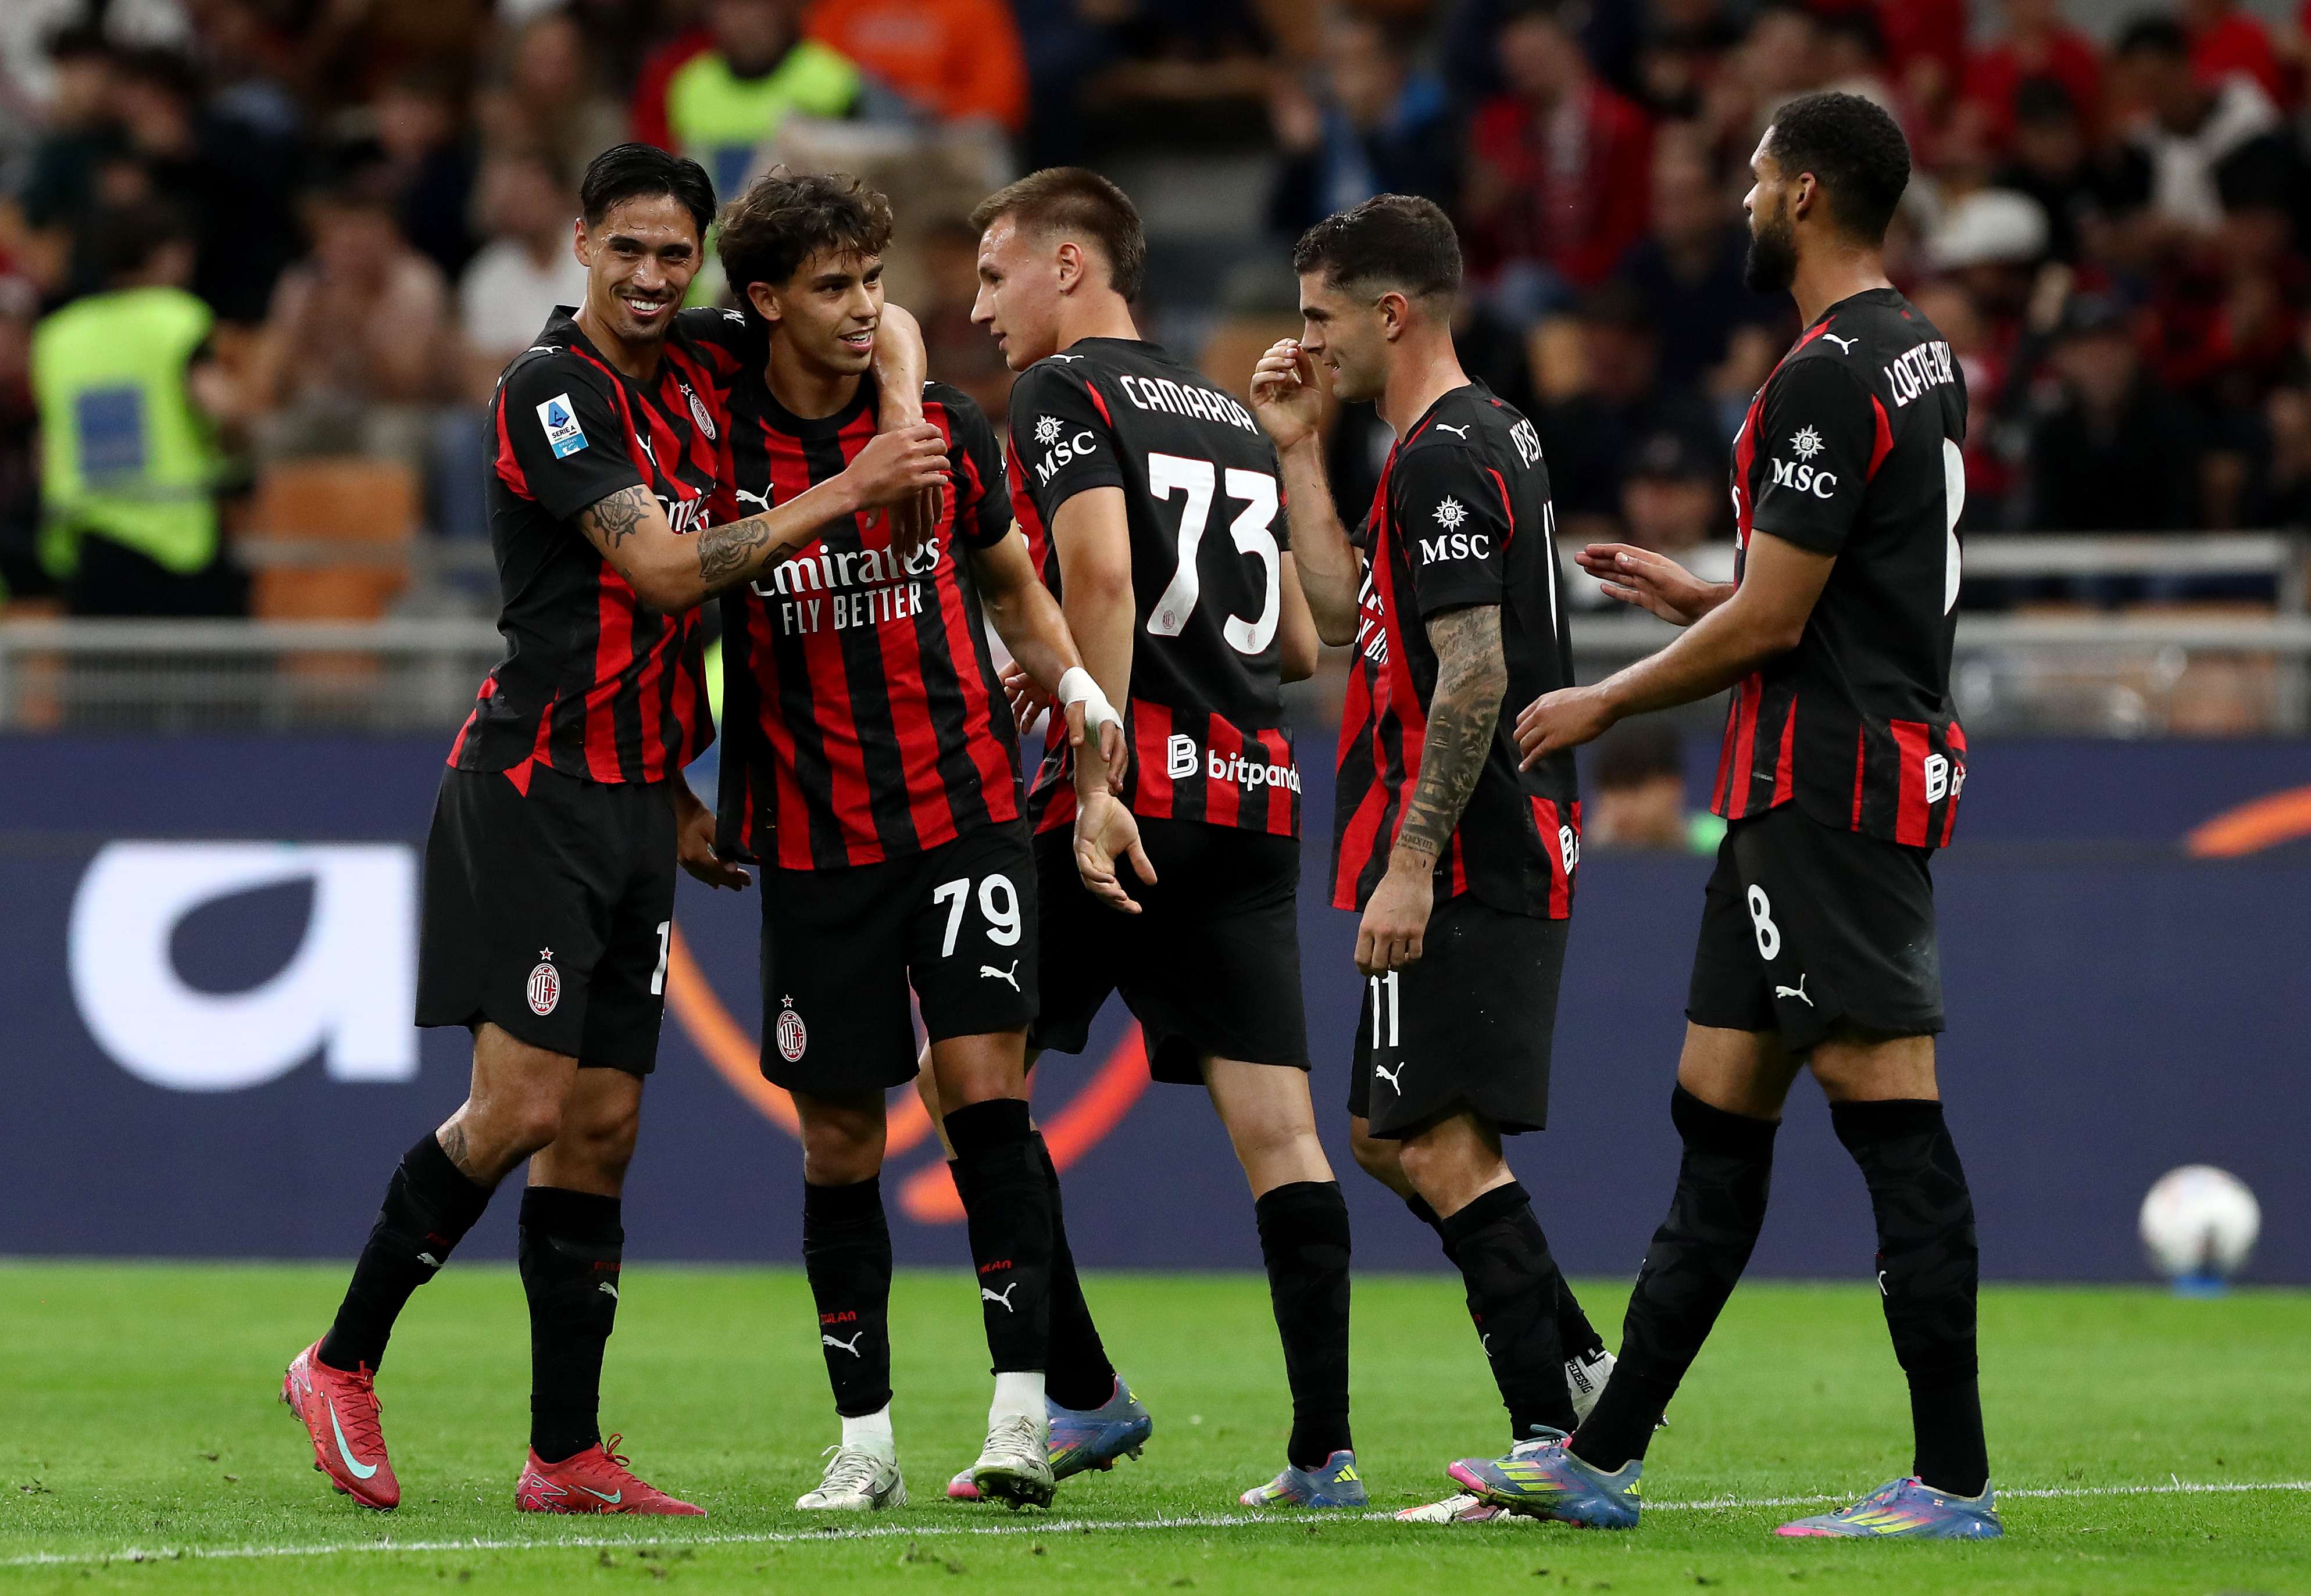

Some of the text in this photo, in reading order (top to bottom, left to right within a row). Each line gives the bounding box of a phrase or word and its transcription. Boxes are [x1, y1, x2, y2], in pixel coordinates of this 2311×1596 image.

[552, 427, 570, 439] SERIE
[1120, 375, 1258, 435] CAMARDA
[1035, 430, 1096, 487] MSC
[1771, 457, 1837, 498] MSC
[1146, 452, 1280, 654] 73
[1419, 534, 1490, 565] MSC
[782, 582, 923, 635] FLY BETTER
[1167, 734, 1302, 795] B bitpanda
[933, 874, 1021, 957] 79
[1748, 884, 1780, 960] 8
[535, 967, 554, 978] ACM
[1370, 970, 1398, 1049] 11
